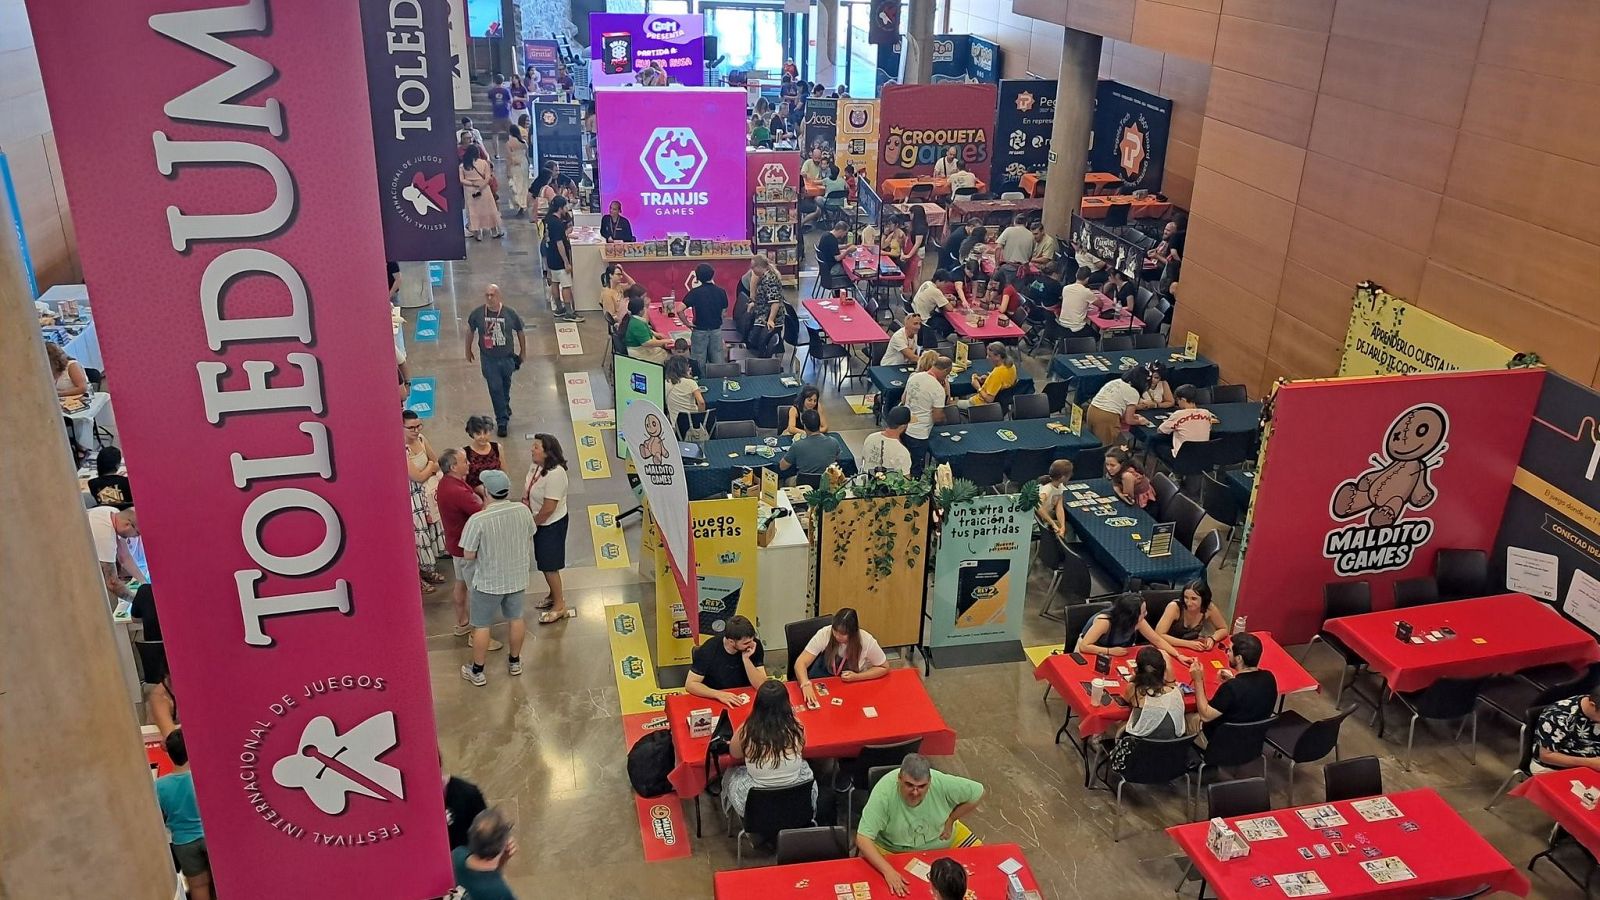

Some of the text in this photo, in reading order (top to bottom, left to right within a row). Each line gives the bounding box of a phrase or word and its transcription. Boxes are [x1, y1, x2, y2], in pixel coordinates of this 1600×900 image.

[646, 30, 684, 40] PRESENTA
[637, 48, 670, 56] PARTIDA
[669, 57, 692, 67] RUSA
[902, 129, 986, 145] CROQUETA
[391, 156, 446, 230] FESTIVAL INTERNACIONAL DE JUEGOS
[640, 192, 708, 206] TRANJIS
[656, 208, 694, 216] GAMES
[151, 0, 349, 646] TOLEDUM
[1356, 338, 1388, 365] DEJARLO
[1370, 326, 1444, 371] APRENDERLO CUESTA
[645, 464, 674, 476] MALDITO
[652, 474, 672, 484] GAMES
[954, 502, 1020, 517] un extra de
[692, 516, 734, 530] juego
[959, 512, 1014, 527] traición a
[694, 526, 742, 538] cartas
[952, 524, 1020, 538] tus partidas
[1330, 524, 1428, 552] MALDITO
[1552, 524, 1588, 550] CONECTAD
[1340, 545, 1408, 570] GAMES
[990, 588, 998, 598] 2
[240, 675, 402, 846] FESTIVAL INTERNACIONAL DE JUEGOS
[654, 818, 664, 838] GAMES
[661, 817, 675, 845] MALDITO
